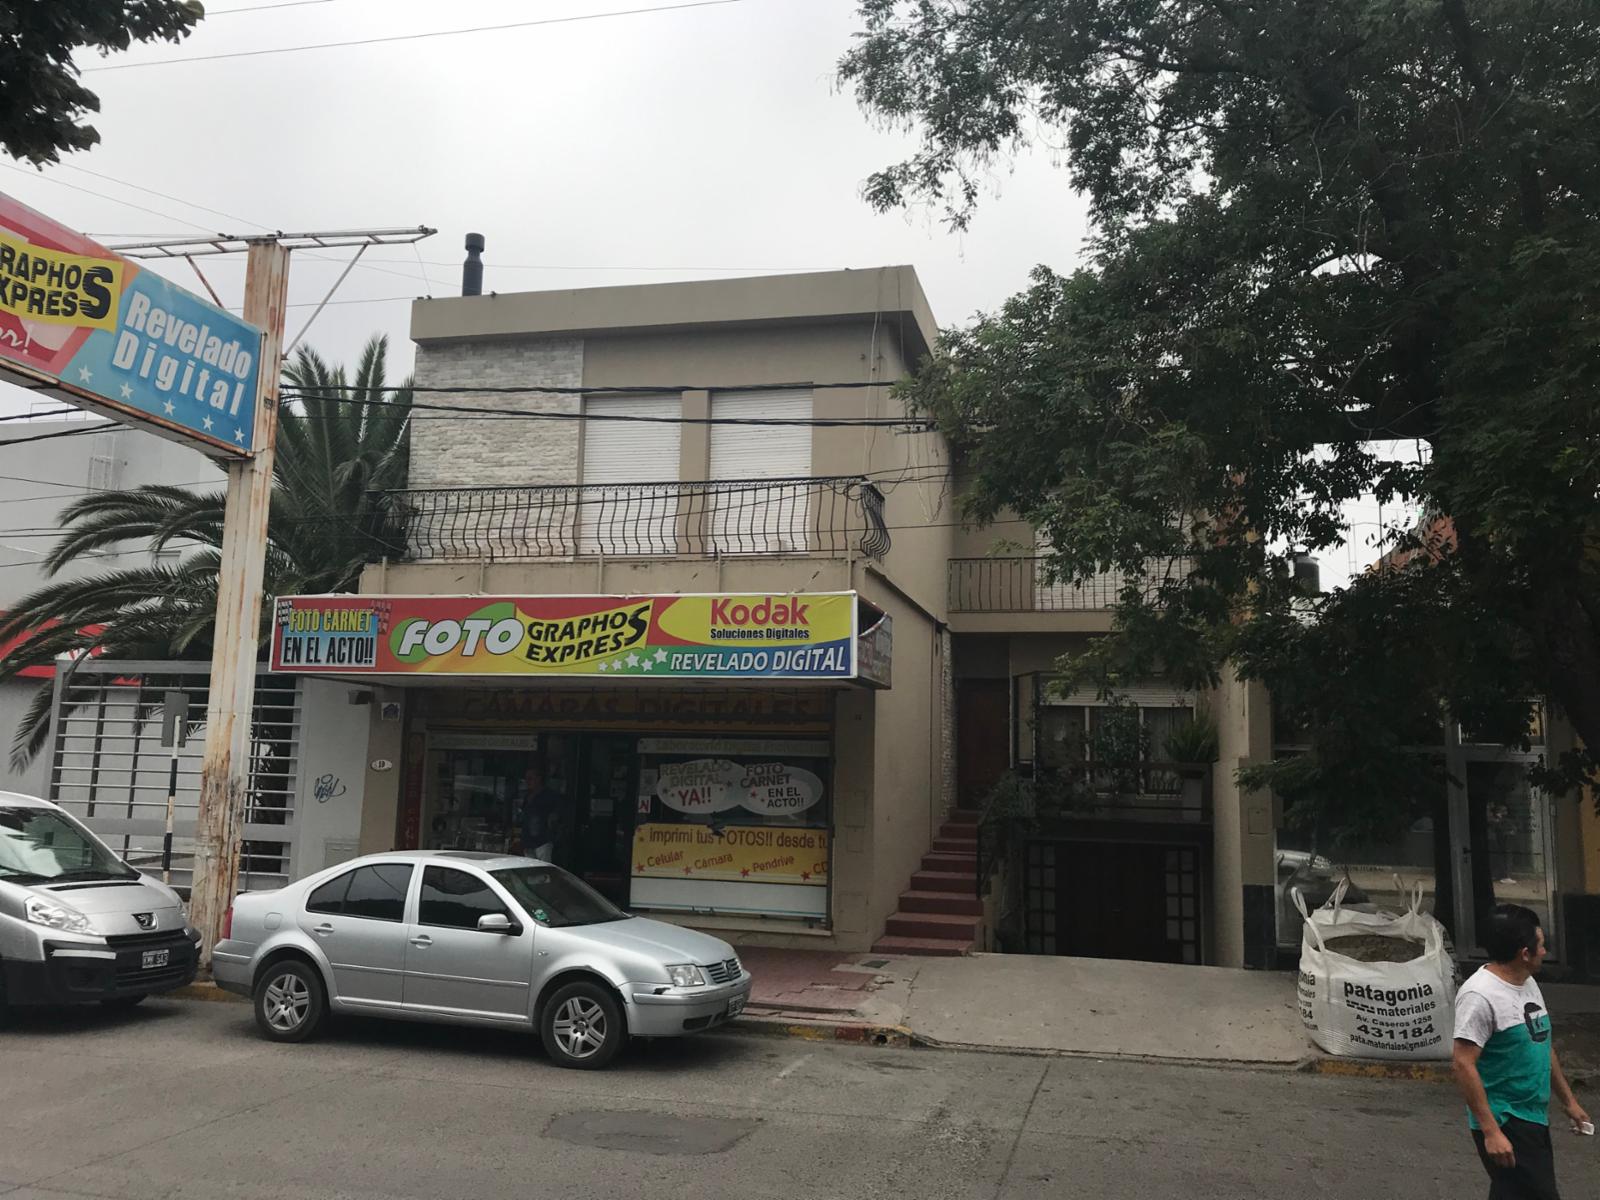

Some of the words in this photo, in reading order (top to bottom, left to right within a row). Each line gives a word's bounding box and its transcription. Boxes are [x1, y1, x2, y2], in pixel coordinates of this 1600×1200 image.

[125, 291, 251, 379] Revelado
[112, 330, 245, 416] Digital
[711, 597, 810, 625] Kodak
[290, 609, 320, 632] FOTO
[323, 608, 374, 632] CARNET
[398, 618, 525, 656] FOTO
[710, 628, 763, 639] Soluciones
[766, 628, 810, 639] Digitales
[283, 637, 302, 663] EN
[306, 637, 320, 663] EL
[326, 637, 373, 663] ACTO!!
[670, 652, 769, 671] REVELADO
[772, 646, 846, 671] DIGITAL
[660, 762, 732, 776] REVELADO
[746, 764, 784, 778] FOTO
[670, 774, 722, 788] DIGITAL
[740, 774, 792, 788] CARNET
[678, 787, 711, 806] YA!!
[768, 788, 785, 798] EN
[787, 787, 801, 797] EL
[767, 798, 804, 809] ACTO!!
[697, 830, 714, 844] tus
[777, 833, 814, 848] desde
[647, 850, 684, 868] Celular
[752, 855, 794, 872] Pendrive
[1344, 981, 1433, 1006] patagonia
[1377, 1000, 1436, 1017] materiales
[1356, 1014, 1369, 1023] Av.
[1372, 1018, 1410, 1027] Caseros
[1357, 1024, 1435, 1039] 431184
